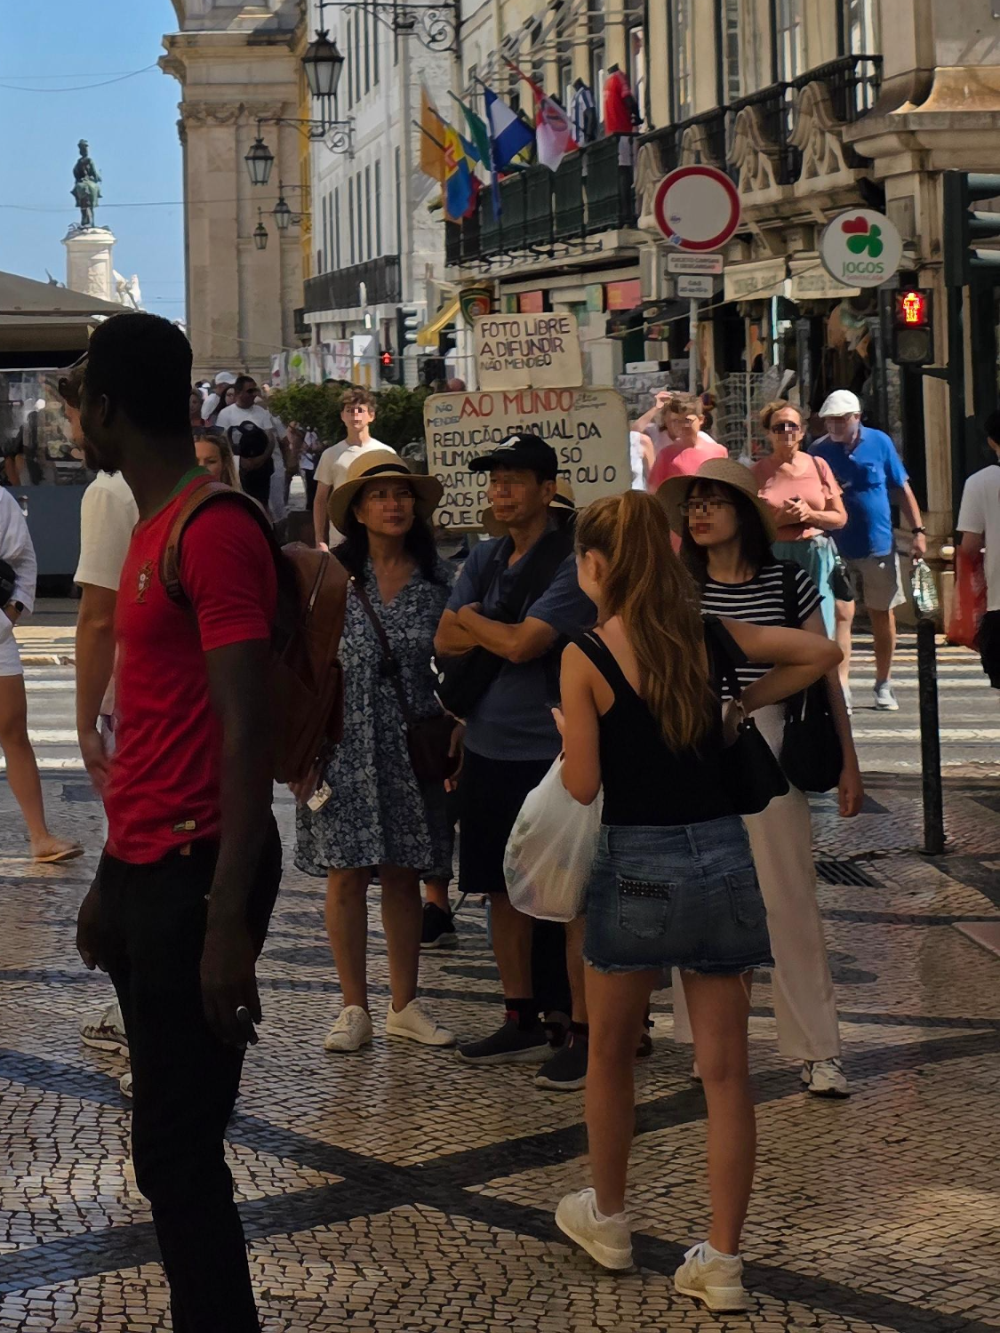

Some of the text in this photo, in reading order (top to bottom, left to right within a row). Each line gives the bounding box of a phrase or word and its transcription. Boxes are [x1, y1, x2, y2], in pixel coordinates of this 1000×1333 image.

[842, 261, 885, 278] JOGOS
[481, 321, 520, 338] FOTO
[480, 341, 494, 356] A
[460, 394, 494, 419] AO
[502, 389, 574, 415] MUNDO
[433, 425, 503, 448] REDUÇÃO
[577, 422, 602, 440] DA
[560, 441, 582, 464] SÓ
[577, 465, 598, 483] OU
[603, 466, 616, 482] O
